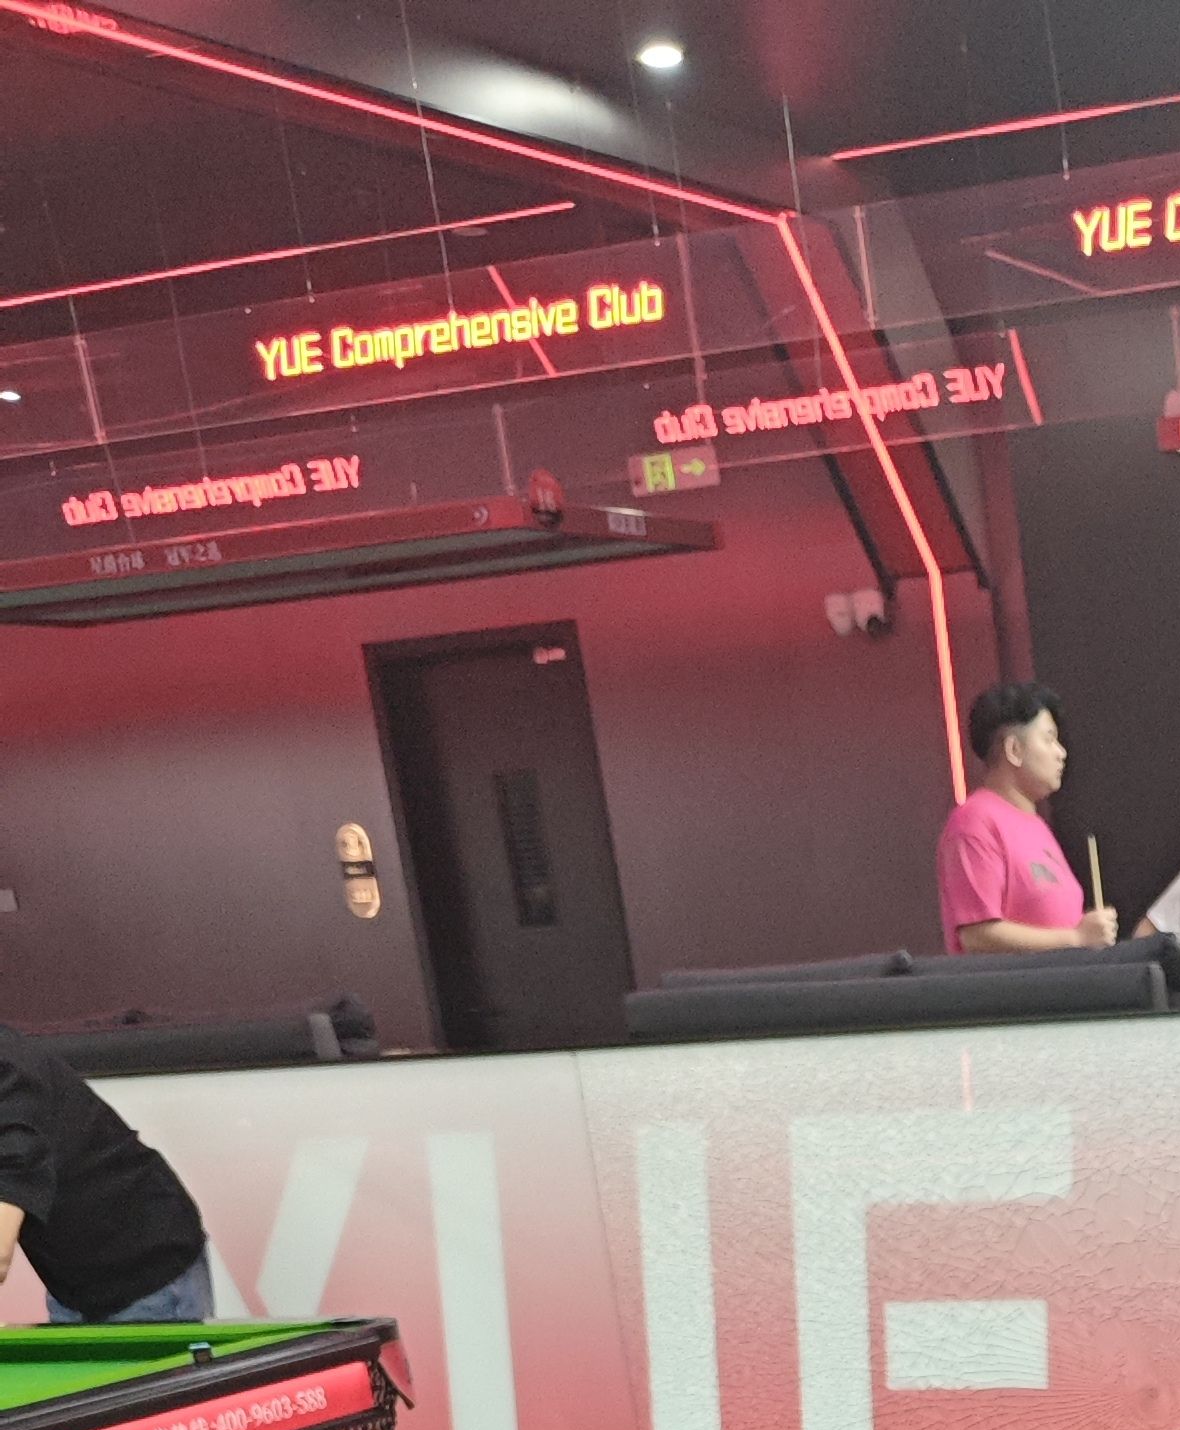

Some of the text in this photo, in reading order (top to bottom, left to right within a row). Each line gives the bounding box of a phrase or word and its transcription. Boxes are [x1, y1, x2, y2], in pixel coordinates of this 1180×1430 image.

[1073, 199, 1152, 256] YUE
[254, 281, 665, 381] YUE Comprehensive Club
